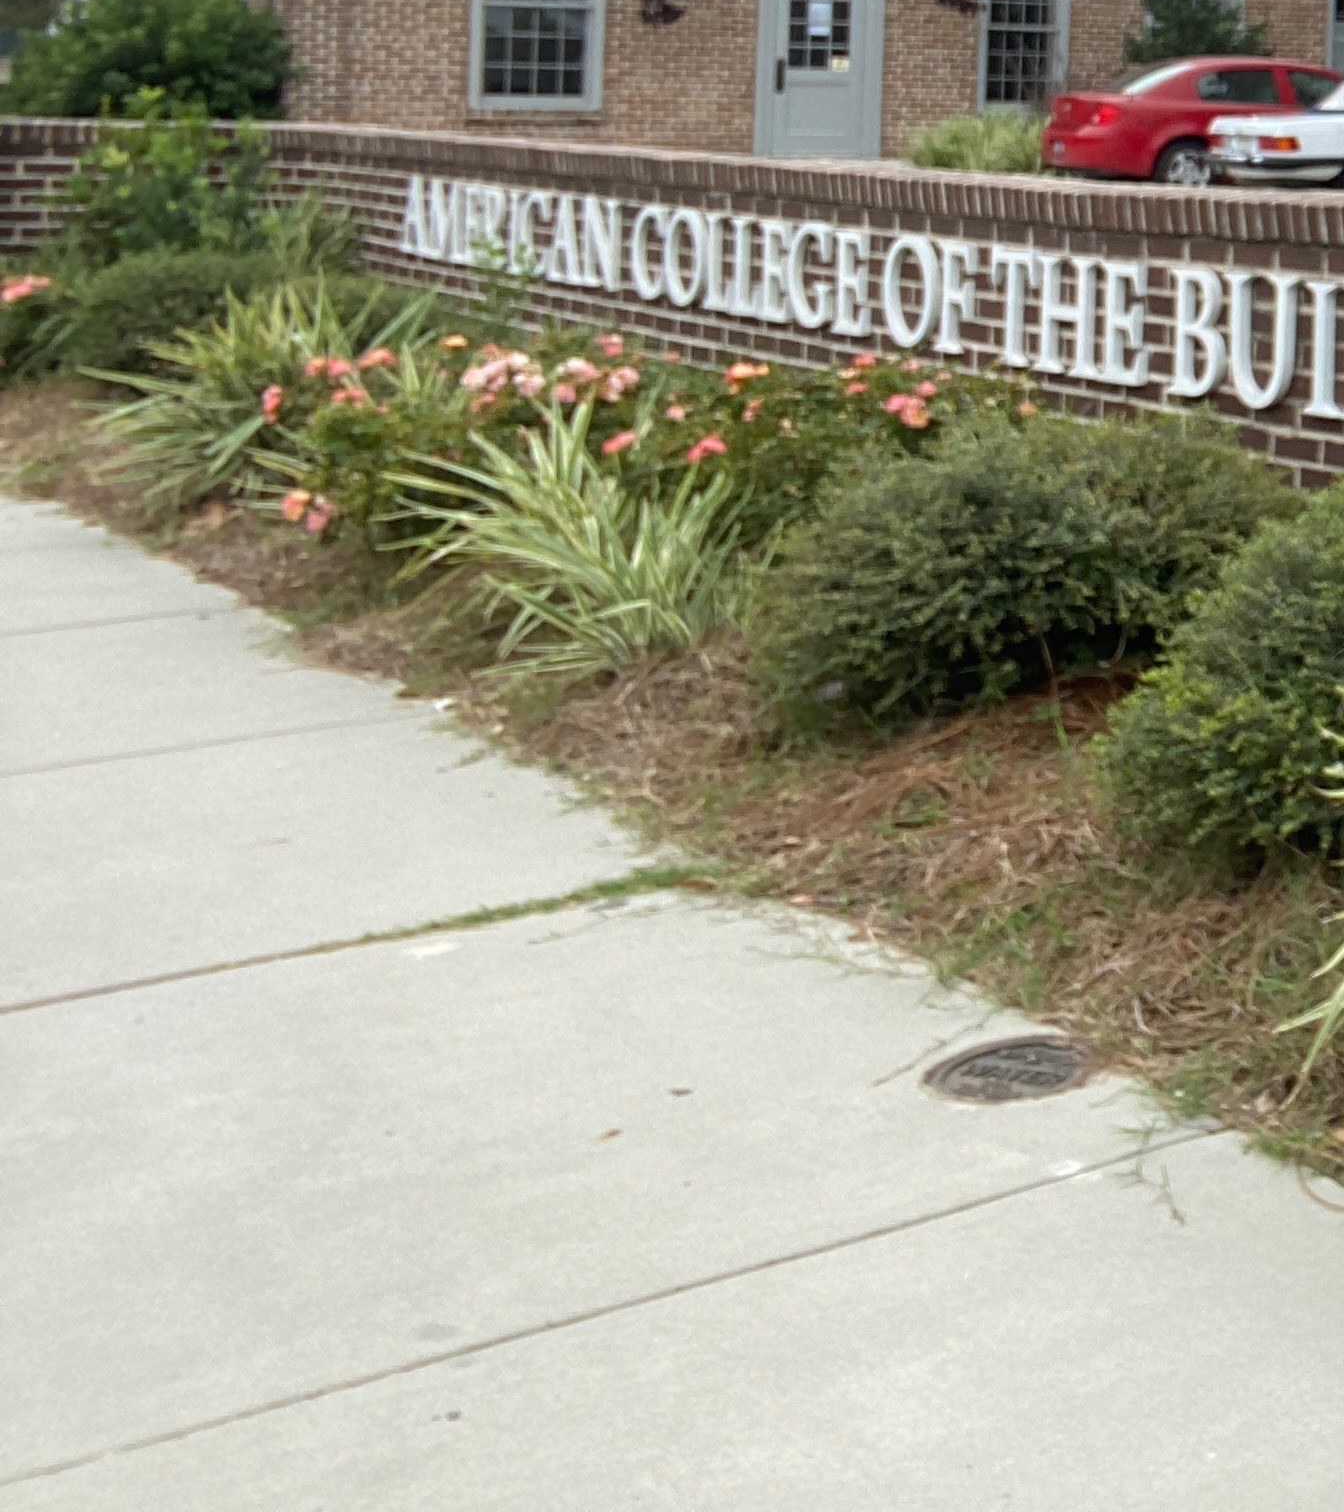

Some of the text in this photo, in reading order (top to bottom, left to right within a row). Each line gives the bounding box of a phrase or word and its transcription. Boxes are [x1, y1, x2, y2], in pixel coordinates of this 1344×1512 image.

[399, 174, 622, 292] AMERICAN
[631, 205, 872, 338] COLLEGE
[883, 232, 978, 355] OF
[991, 244, 1150, 387] THE
